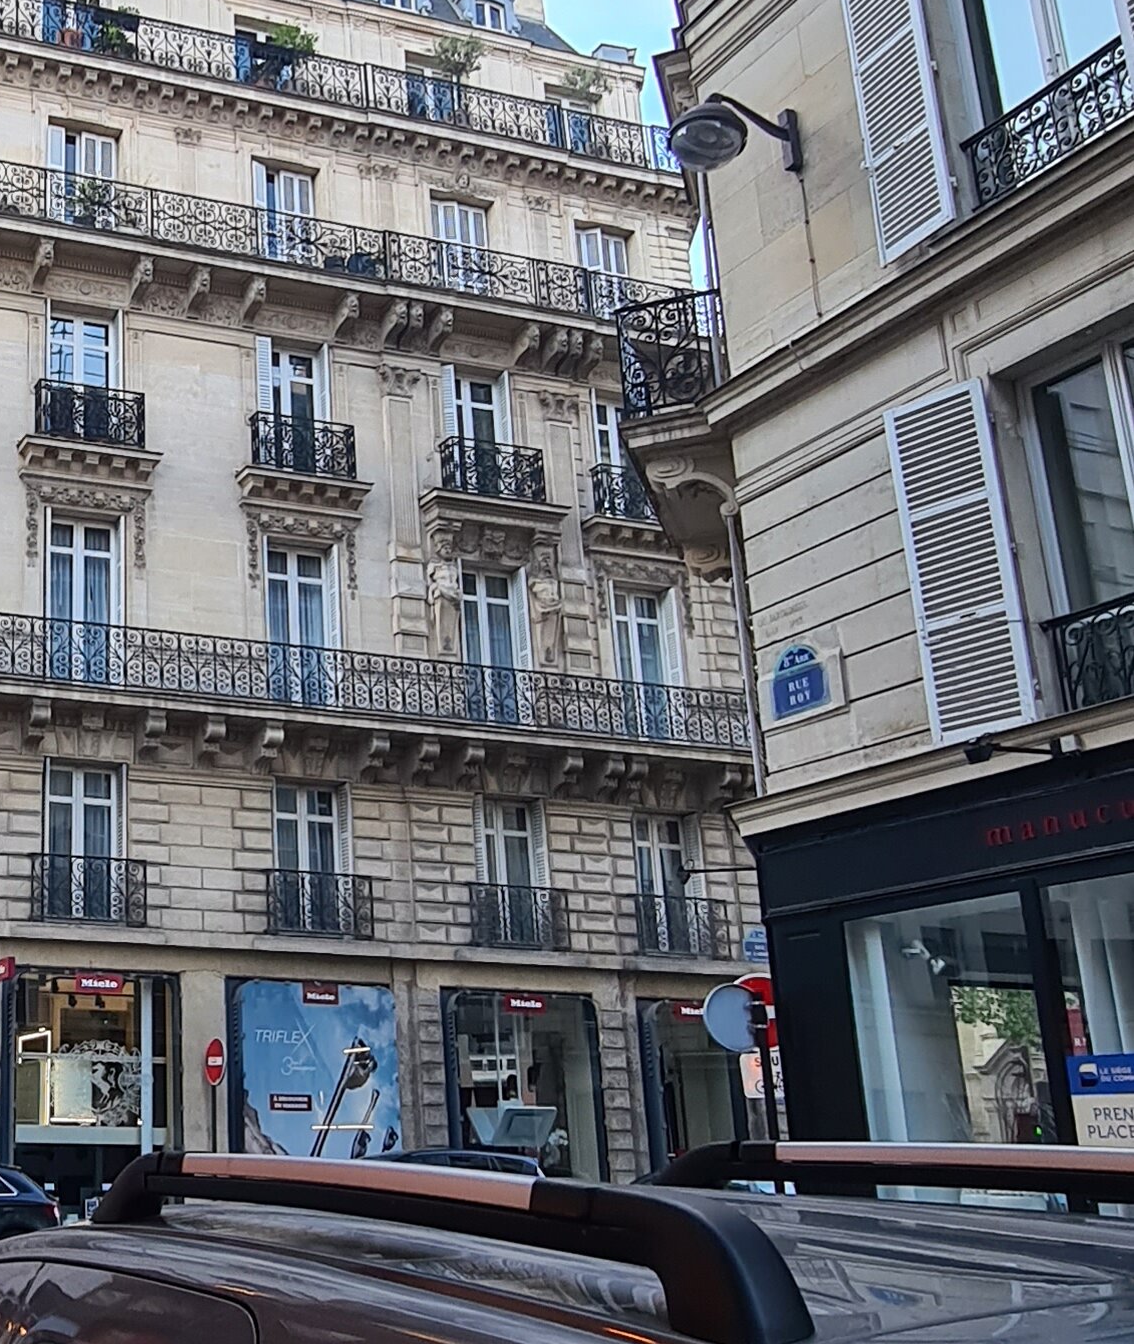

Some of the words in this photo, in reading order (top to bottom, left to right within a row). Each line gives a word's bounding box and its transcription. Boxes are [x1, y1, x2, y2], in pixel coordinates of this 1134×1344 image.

[788, 677, 809, 692] RUE
[790, 690, 811, 706] ROY
[80, 978, 118, 989] Miele
[306, 992, 336, 1001] Miele
[510, 998, 542, 1008] Miele
[680, 1006, 704, 1016] Miel
[255, 1018, 316, 1059] TRIFLEX
